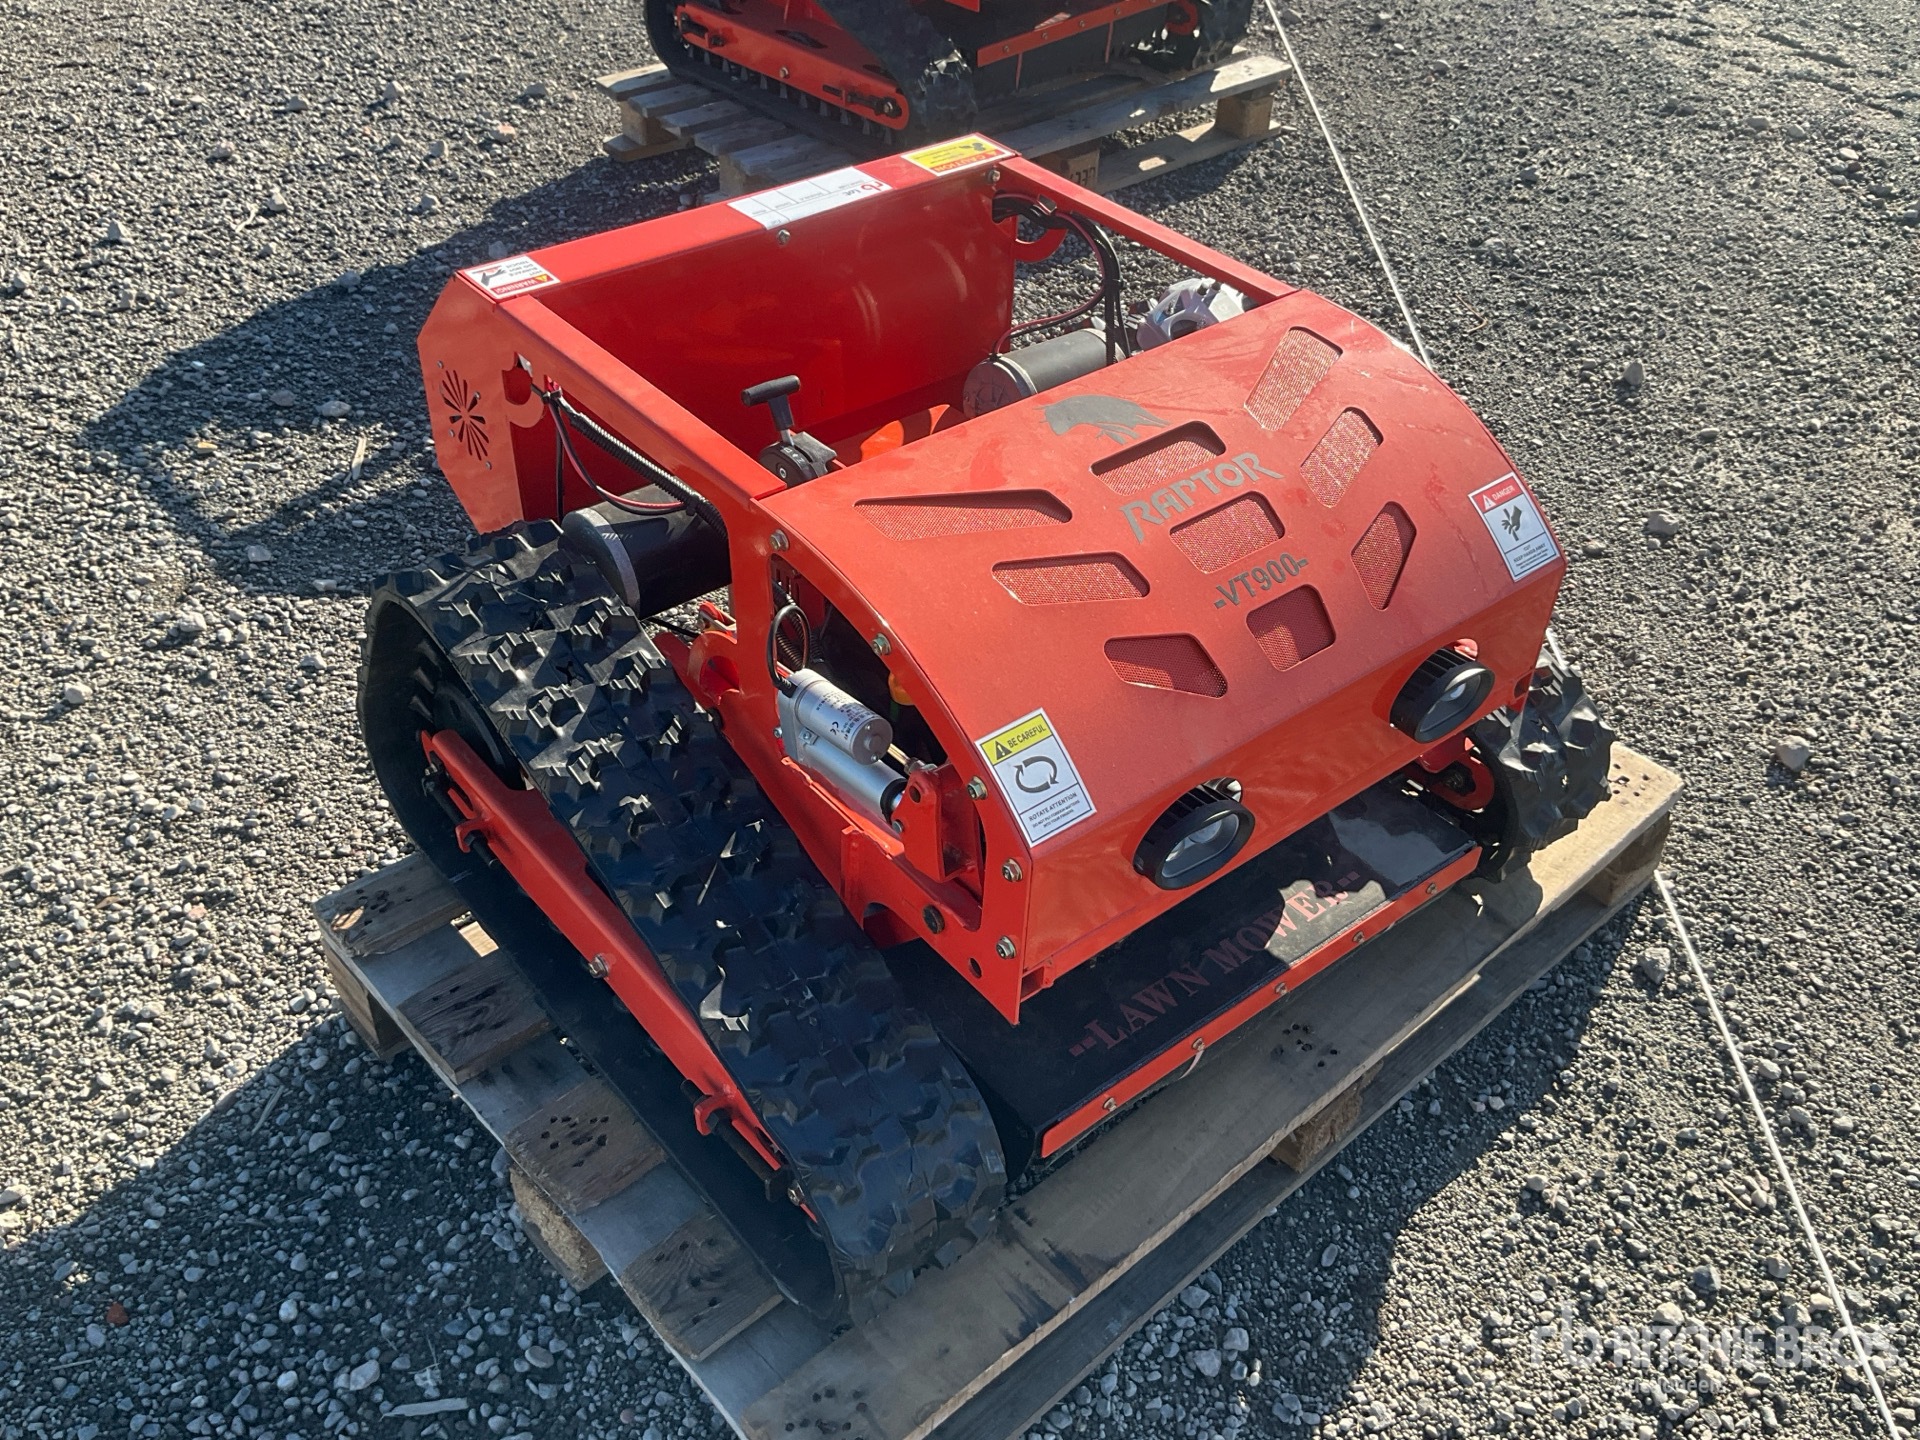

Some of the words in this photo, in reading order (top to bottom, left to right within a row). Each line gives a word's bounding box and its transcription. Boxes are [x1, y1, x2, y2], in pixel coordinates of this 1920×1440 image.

[1119, 452, 1286, 545] RAPTOR
[1491, 485, 1516, 501] DANGER
[1006, 737, 1018, 748] BE
[1016, 724, 1047, 743] CAREFUL
[1028, 806, 1050, 821] ROTATE
[1049, 792, 1077, 810] ATTENTION
